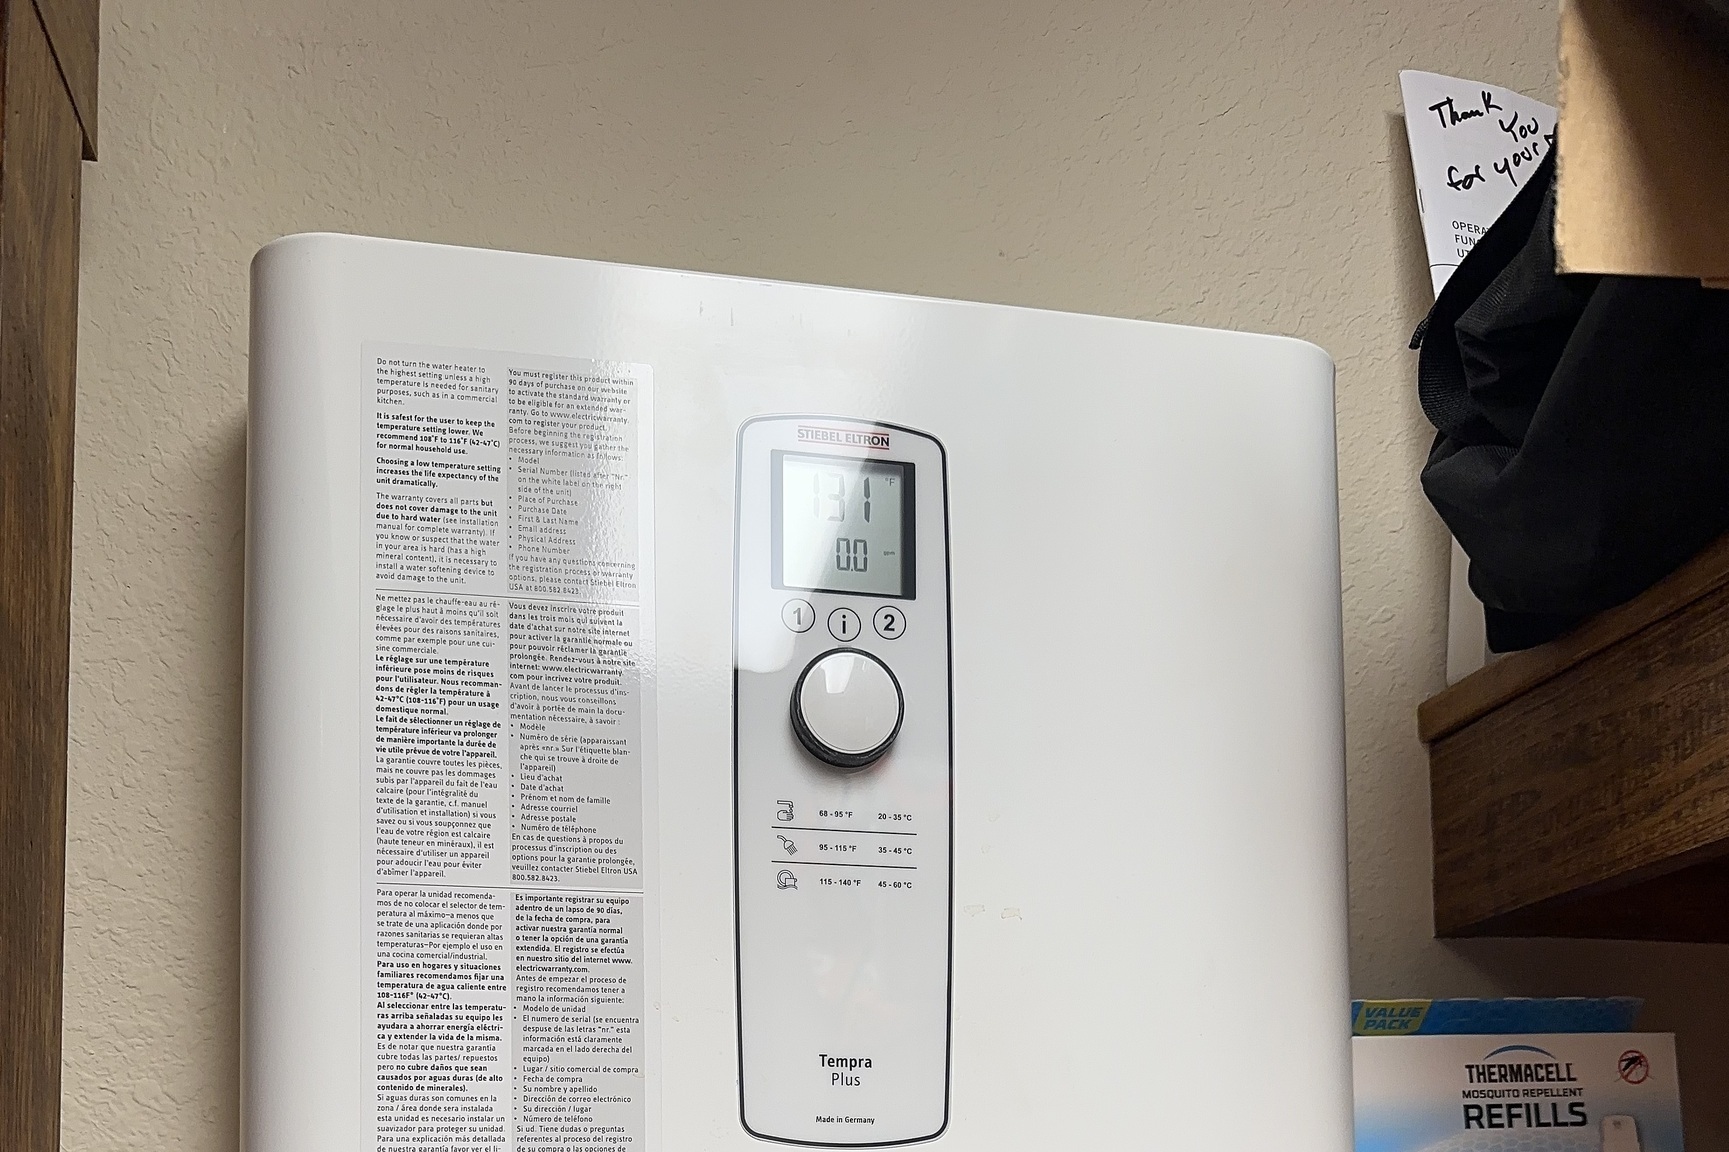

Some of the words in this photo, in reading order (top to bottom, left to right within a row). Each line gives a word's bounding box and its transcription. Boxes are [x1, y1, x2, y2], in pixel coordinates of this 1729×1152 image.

[1428, 90, 1502, 128] Thank
[1498, 111, 1539, 142] You
[1447, 165, 1486, 191] for
[1494, 142, 1539, 187] your
[1452, 220, 1489, 235] OPERA
[1454, 234, 1478, 246] FUN
[383, 412, 389, 420] is
[391, 413, 412, 421] safest
[414, 414, 425, 422] for
[426, 415, 437, 423] the
[465, 418, 482, 428] keep
[483, 420, 495, 428] the
[797, 428, 842, 442] STIEBEL
[845, 432, 890, 446] ELTRON
[376, 456, 408, 467] Choosing
[416, 459, 430, 467] low
[431, 461, 475, 471] temperature
[476, 464, 501, 474] setting
[813, 473, 870, 523] 131
[792, 608, 802, 625] 1
[883, 614, 895, 632] 2
[842, 614, 847, 634] i
[375, 653, 384, 662] Le
[385, 654, 413, 664] réglage
[444, 658, 489, 667] température
[818, 809, 828, 817] 68
[834, 810, 843, 818] 95
[877, 812, 886, 820] 20
[892, 813, 901, 821] 35
[522, 824, 549, 832] Numéro
[562, 824, 596, 834] téléphone
[818, 843, 828, 851] 95
[834, 844, 847, 852] 115
[878, 846, 887, 854] 35
[819, 877, 832, 885] 115
[838, 878, 851, 886] 140
[877, 880, 887, 888] 45
[892, 881, 901, 889] 60
[515, 893, 523, 901] Es
[524, 893, 563, 903] importante
[564, 894, 594, 905] registrar
[595, 896, 604, 904] su
[605, 896, 629, 906] equipo
[376, 970, 414, 979] familiares
[415, 972, 472, 981] recomendamos
[473, 972, 489, 982] fijar
[1364, 1007, 1423, 1018] VALUE
[1363, 1018, 1412, 1030] PACK
[818, 1054, 872, 1071] Tempra
[831, 1072, 860, 1086] Plus
[1465, 1063, 1577, 1083] THERMACELL
[1462, 1089, 1520, 1100] MOSQUITO
[1522, 1088, 1583, 1098] REPELLENT
[815, 1115, 834, 1123] Made
[836, 1115, 843, 1123] in
[844, 1115, 875, 1125] Germany
[1463, 1102, 1588, 1129] REFILLS
